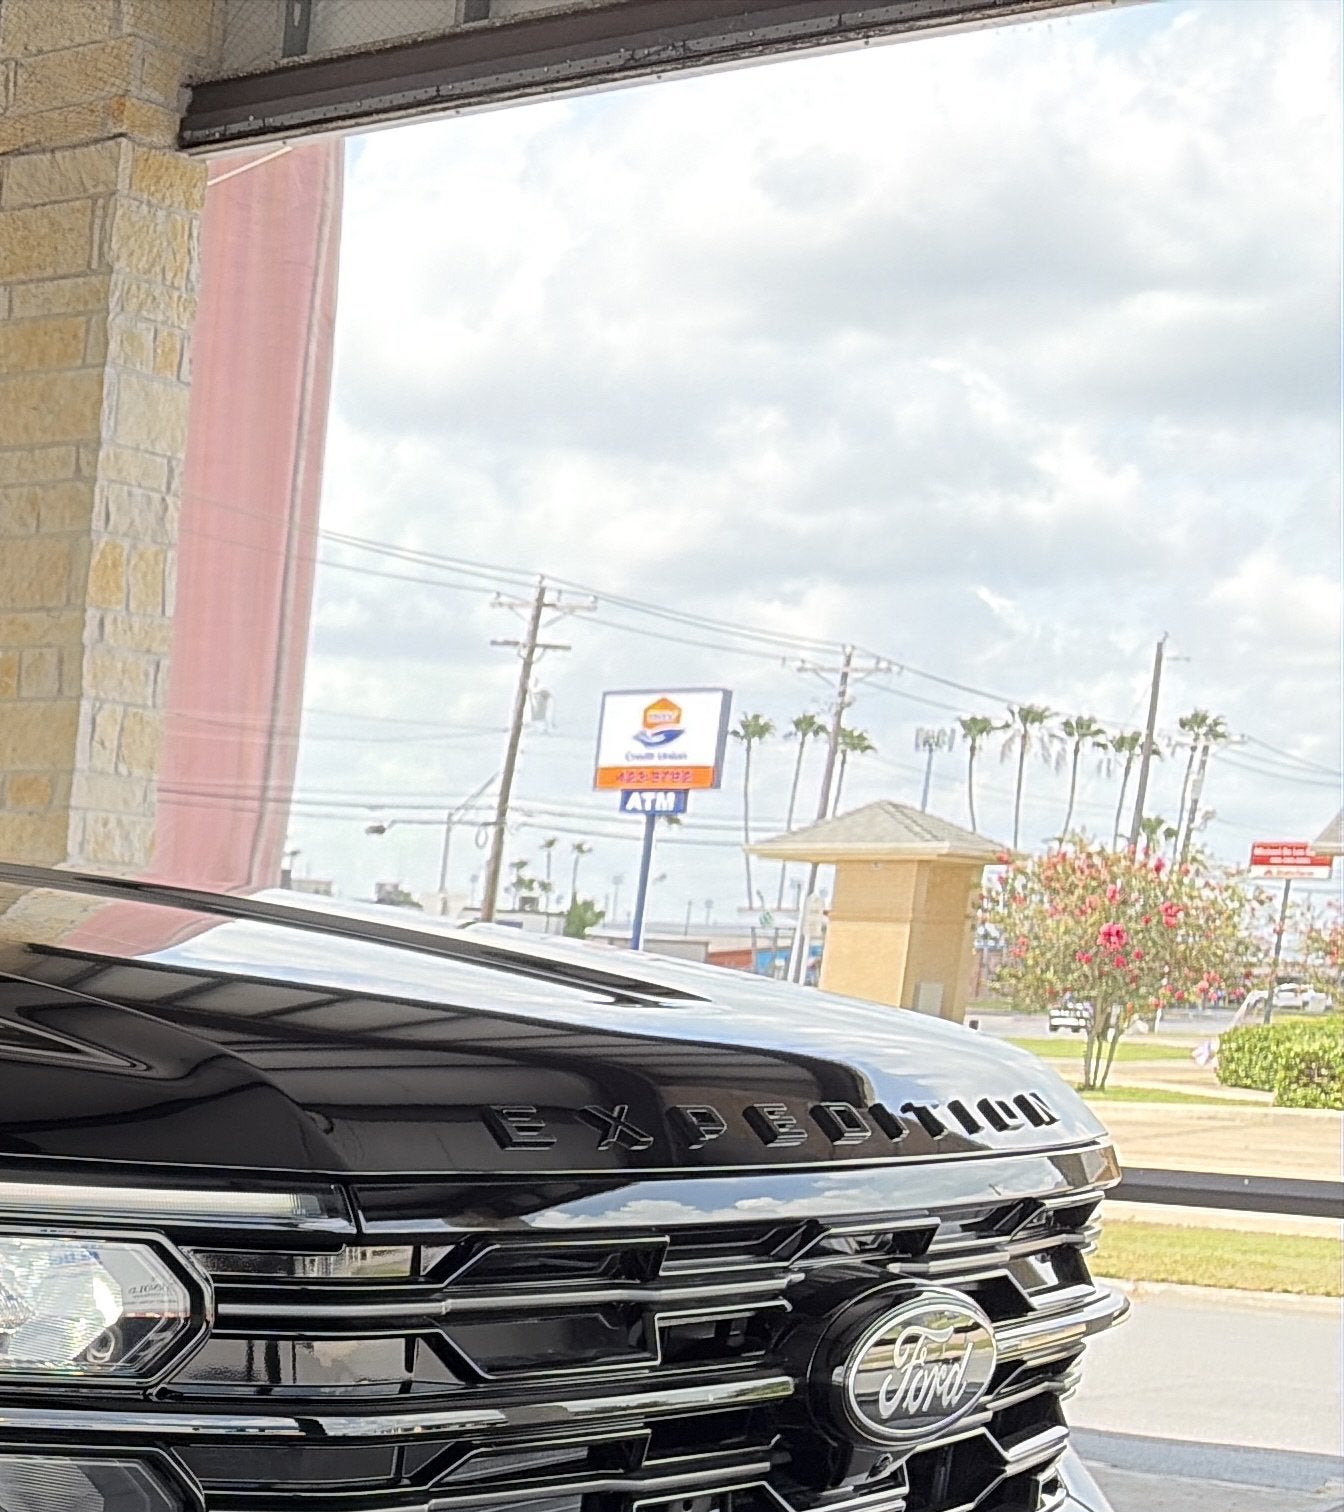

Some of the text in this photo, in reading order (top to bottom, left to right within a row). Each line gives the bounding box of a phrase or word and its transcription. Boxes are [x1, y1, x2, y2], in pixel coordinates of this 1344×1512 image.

[625, 791, 676, 812] ATM
[483, 1091, 1061, 1151] EXPEDITION
[878, 1325, 974, 1420] Ford
